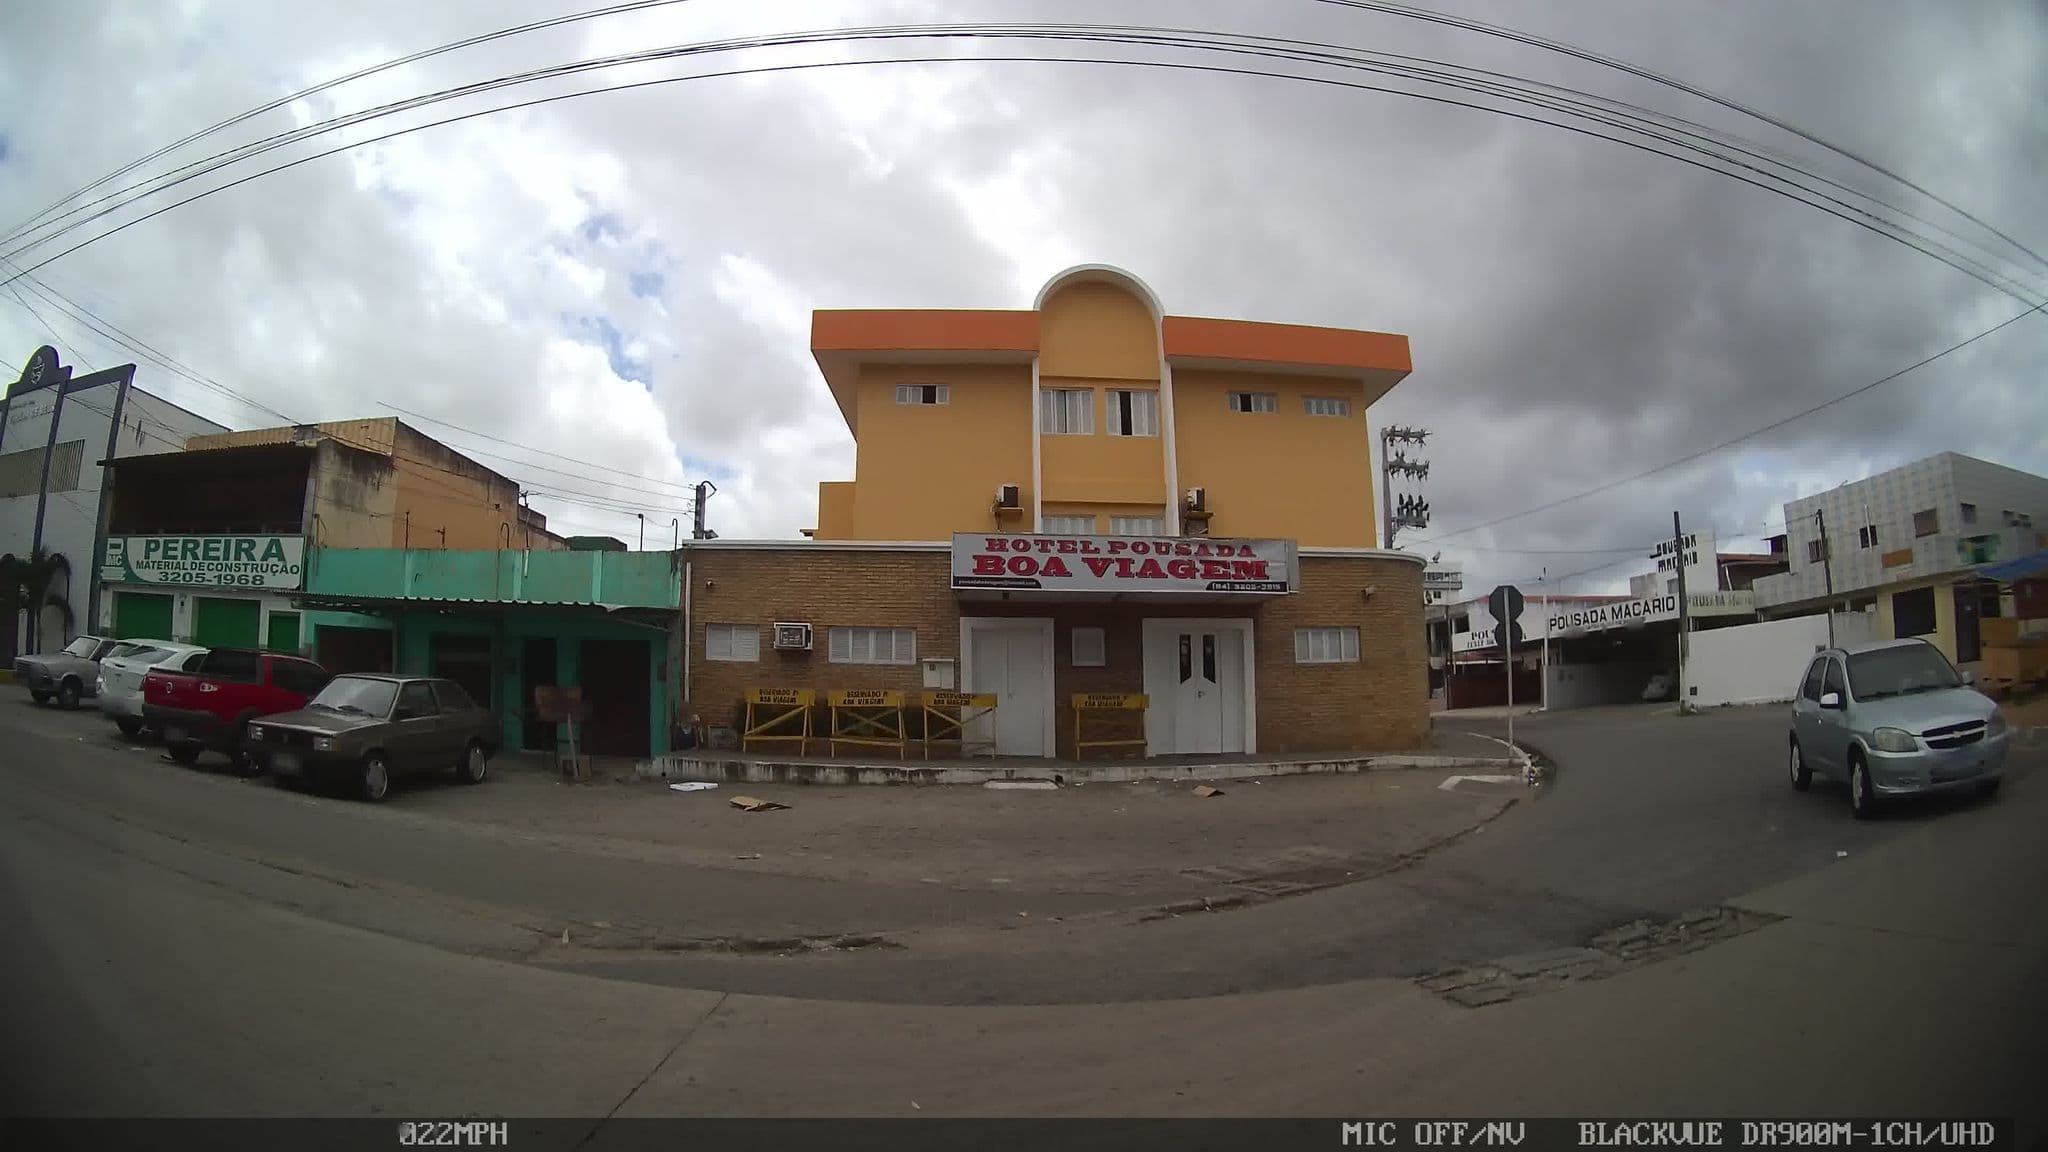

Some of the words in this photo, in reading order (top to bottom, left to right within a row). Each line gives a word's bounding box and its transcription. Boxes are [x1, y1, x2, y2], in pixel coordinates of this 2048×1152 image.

[144, 538, 286, 562] PEREIRA
[985, 538, 1100, 554] HOTEL
[1107, 540, 1257, 557] POUSADA
[136, 560, 188, 571] MATERIAL
[190, 561, 205, 572] DE
[972, 554, 1073, 577] BOA
[1082, 556, 1270, 581] VIAGEM
[1658, 551, 1698, 573] MACRIO
[158, 571, 265, 586] 3205-1968
[1549, 608, 1608, 632] POUSADA
[1611, 595, 1676, 621] MACARIO
